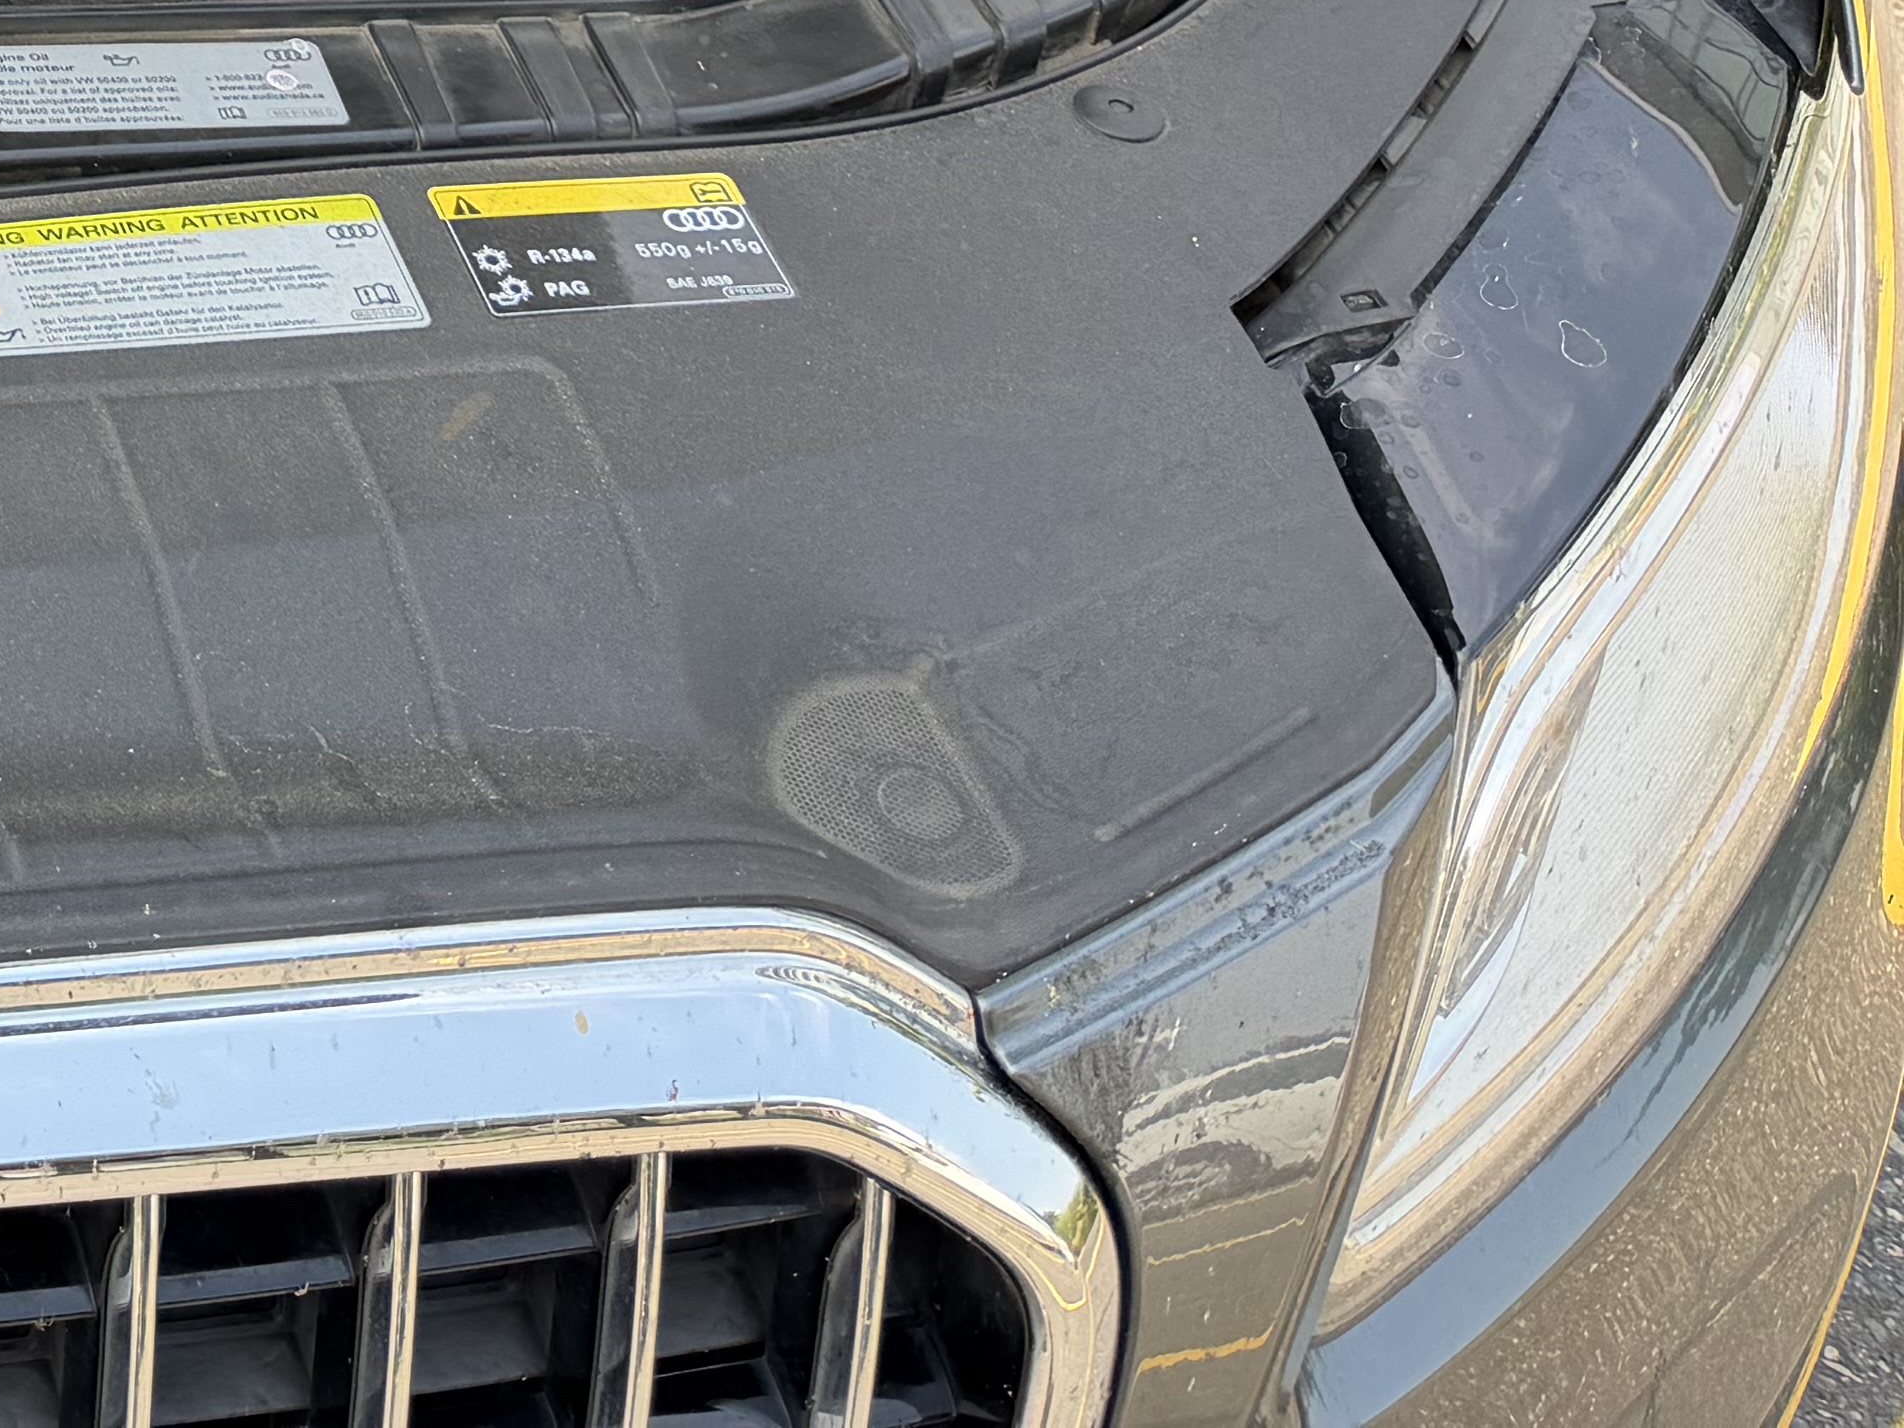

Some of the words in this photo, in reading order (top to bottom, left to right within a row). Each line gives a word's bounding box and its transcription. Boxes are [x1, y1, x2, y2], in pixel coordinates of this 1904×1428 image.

[27, 52, 49, 60] Oil
[20, 63, 76, 72] moteur
[39, 219, 166, 242] WARNING
[180, 206, 320, 230] ATTENTION
[526, 247, 596, 264] R-134a
[633, 241, 692, 260] 550g
[543, 280, 590, 297] PAG
[665, 277, 697, 288] SAE
[697, 274, 733, 286] J639
